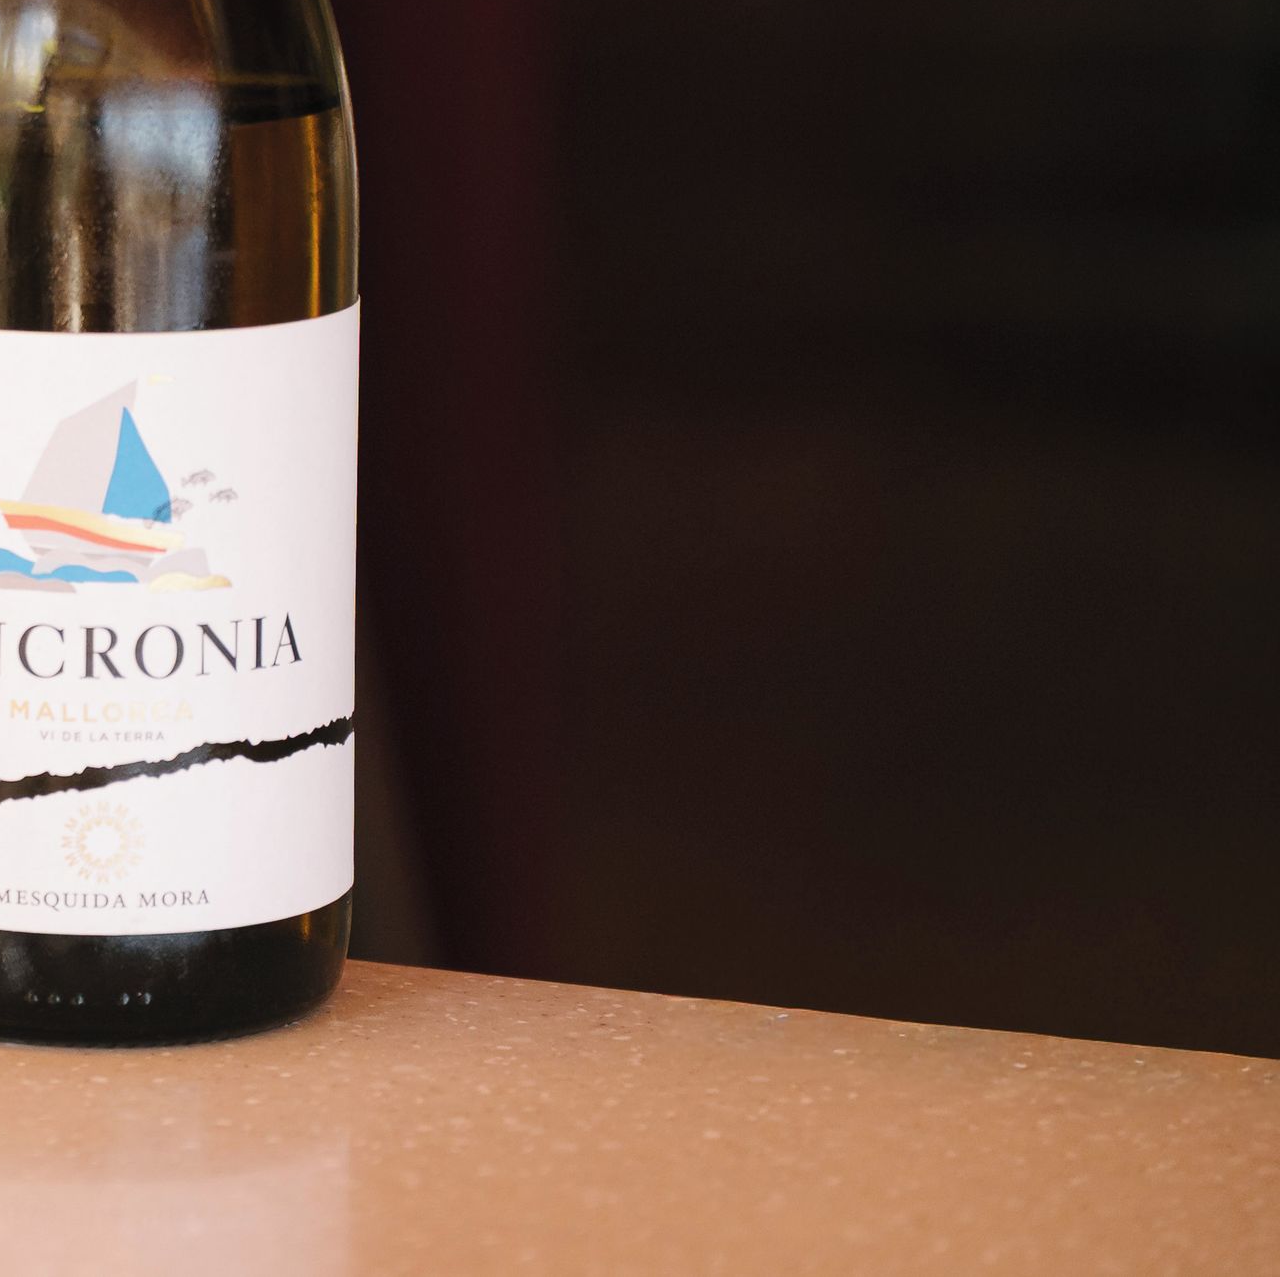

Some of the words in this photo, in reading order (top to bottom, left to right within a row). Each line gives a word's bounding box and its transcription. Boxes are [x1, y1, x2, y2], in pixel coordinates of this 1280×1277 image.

[40, 730, 56, 742] VI
[62, 731, 82, 743] DE
[89, 731, 109, 743] LA
[114, 731, 166, 743] TERRA
[138, 889, 210, 909] MORA
